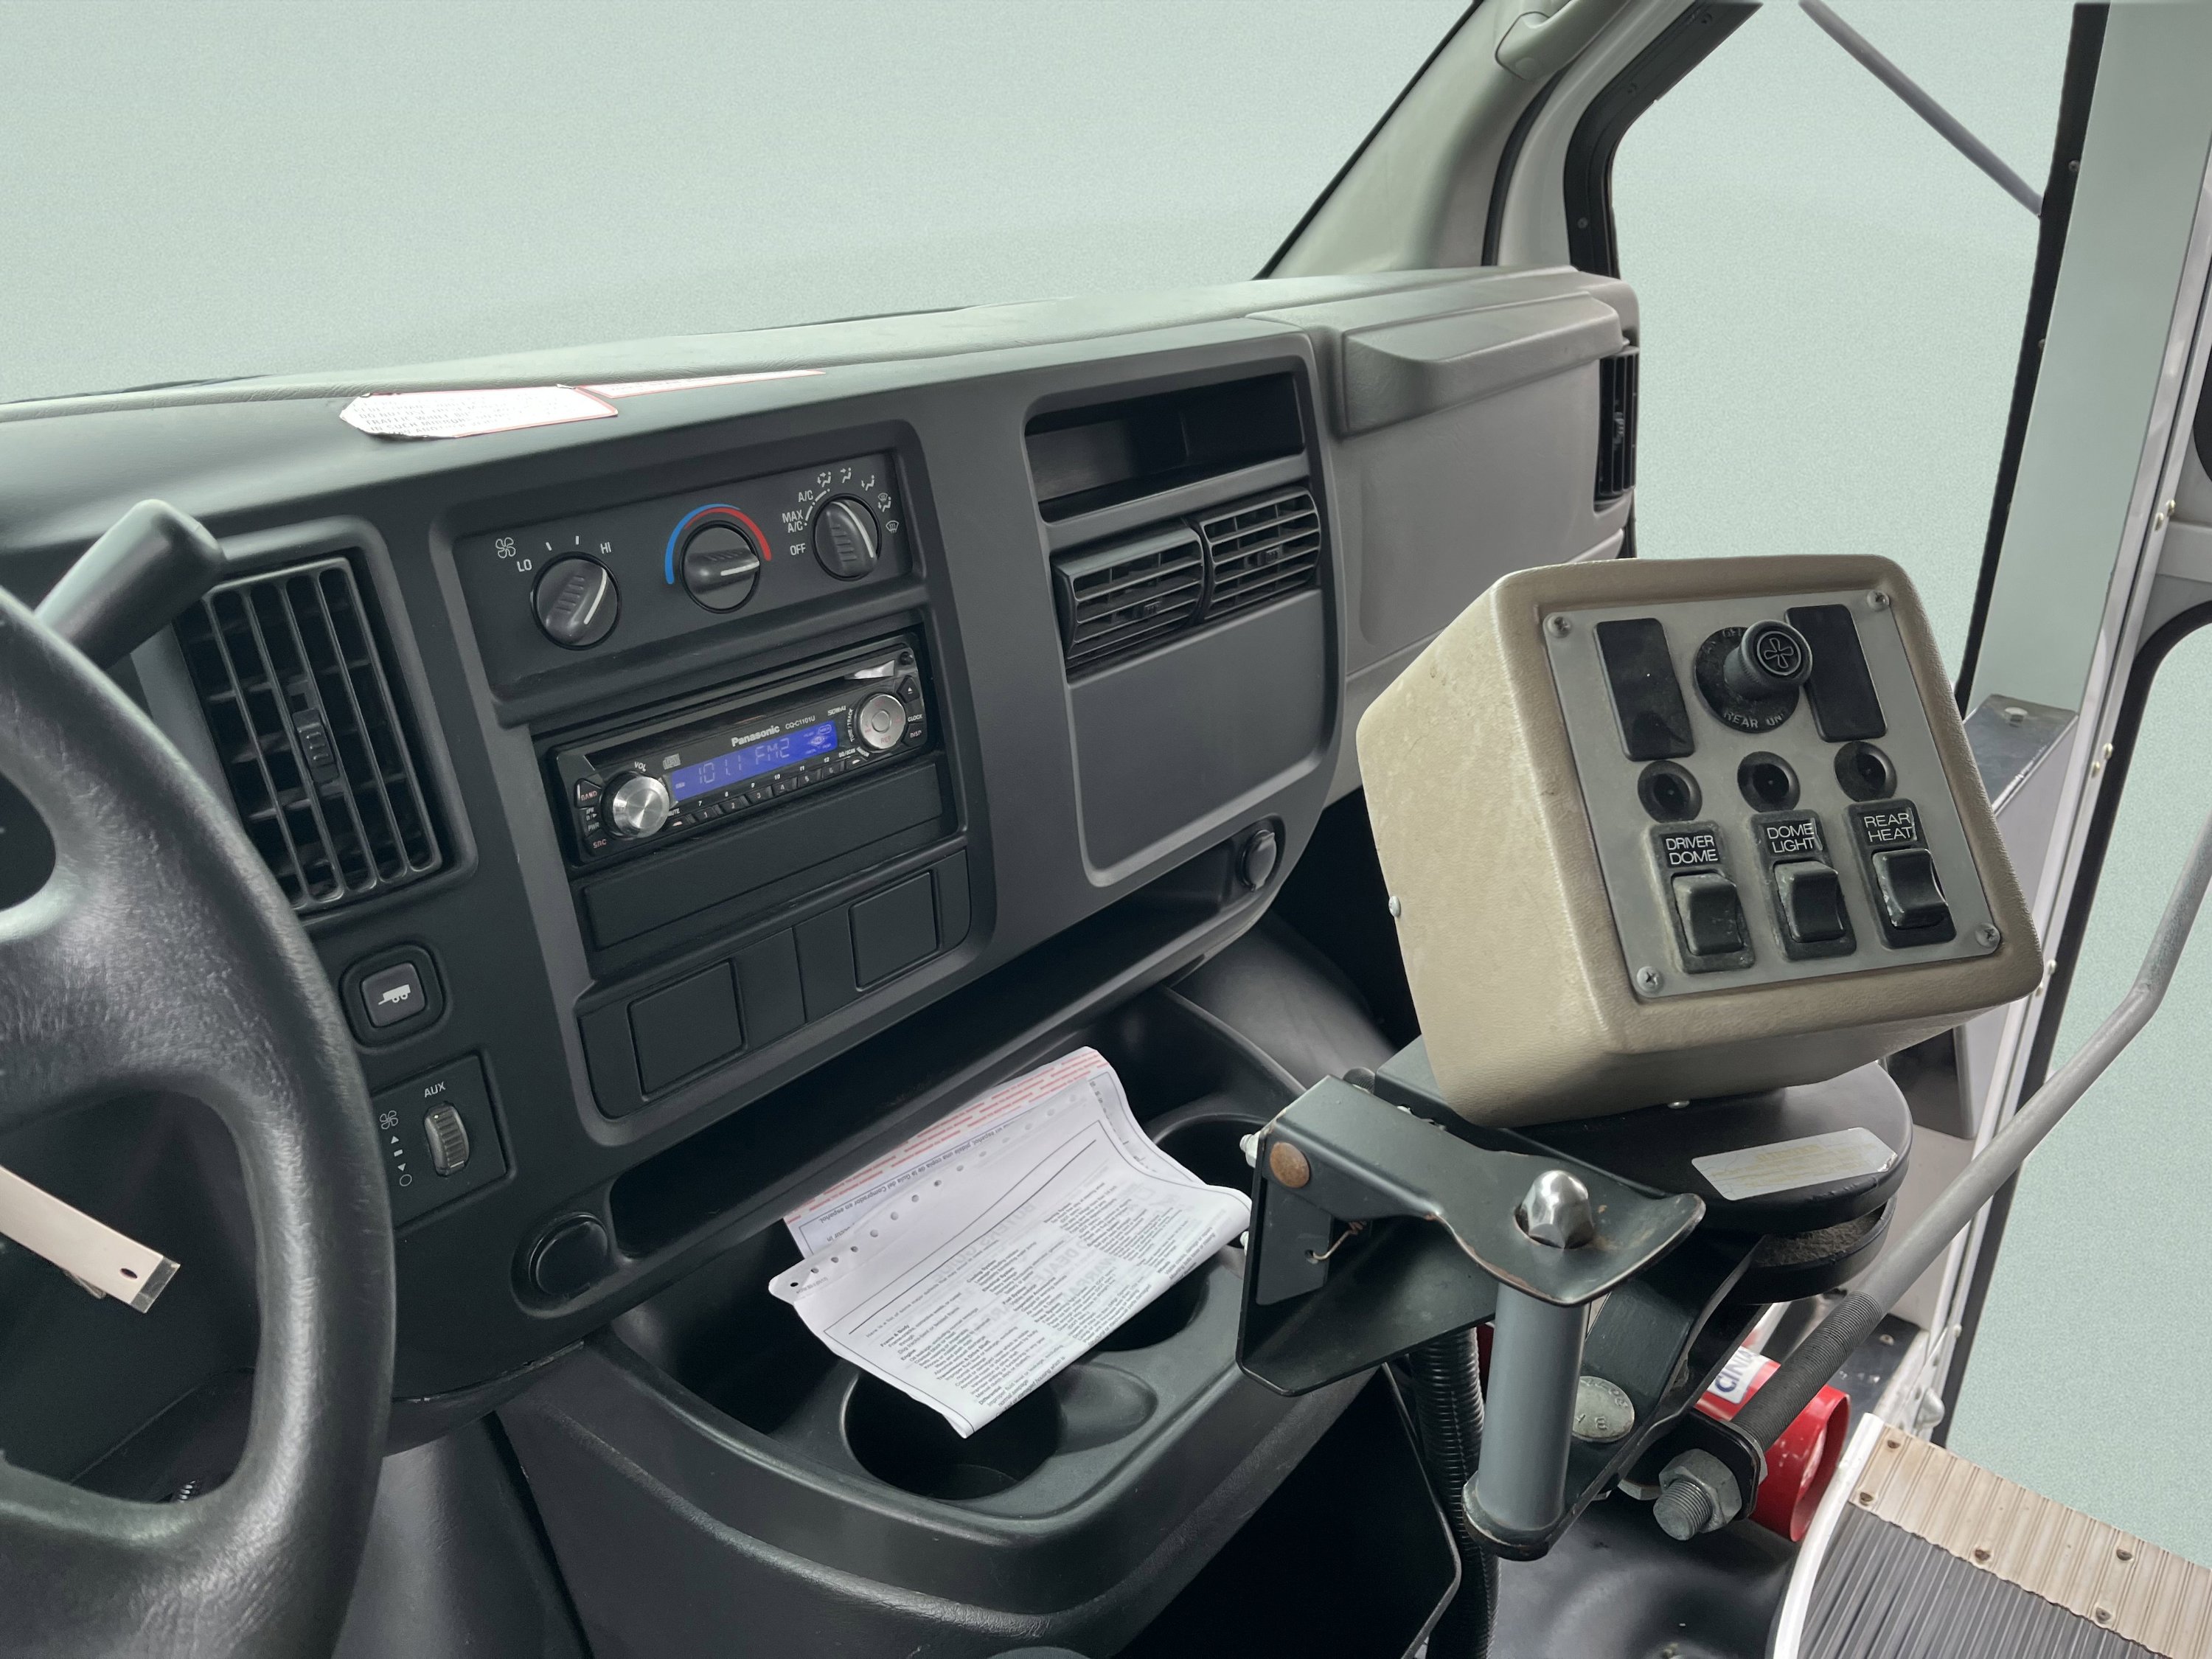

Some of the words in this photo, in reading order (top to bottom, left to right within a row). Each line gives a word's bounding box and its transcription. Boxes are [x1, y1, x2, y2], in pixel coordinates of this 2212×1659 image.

[797, 490, 814, 504] A/C
[782, 509, 804, 524] MAX
[787, 519, 804, 533] A/C
[600, 542, 612, 554] HI
[789, 543, 807, 557] OFF
[516, 558, 532, 573] LO
[731, 725, 781, 748] Panasonic
[754, 737, 790, 766] FM2
[634, 761, 647, 772] VOL
[1864, 812, 1911, 828] REAR
[1767, 821, 1814, 838] DOME
[1868, 826, 1913, 842] HEAT
[1666, 834, 1715, 851] DRIVER
[1771, 835, 1815, 853] LIGHT
[1669, 848, 1719, 865] DOME
[423, 1081, 447, 1098] AUX
